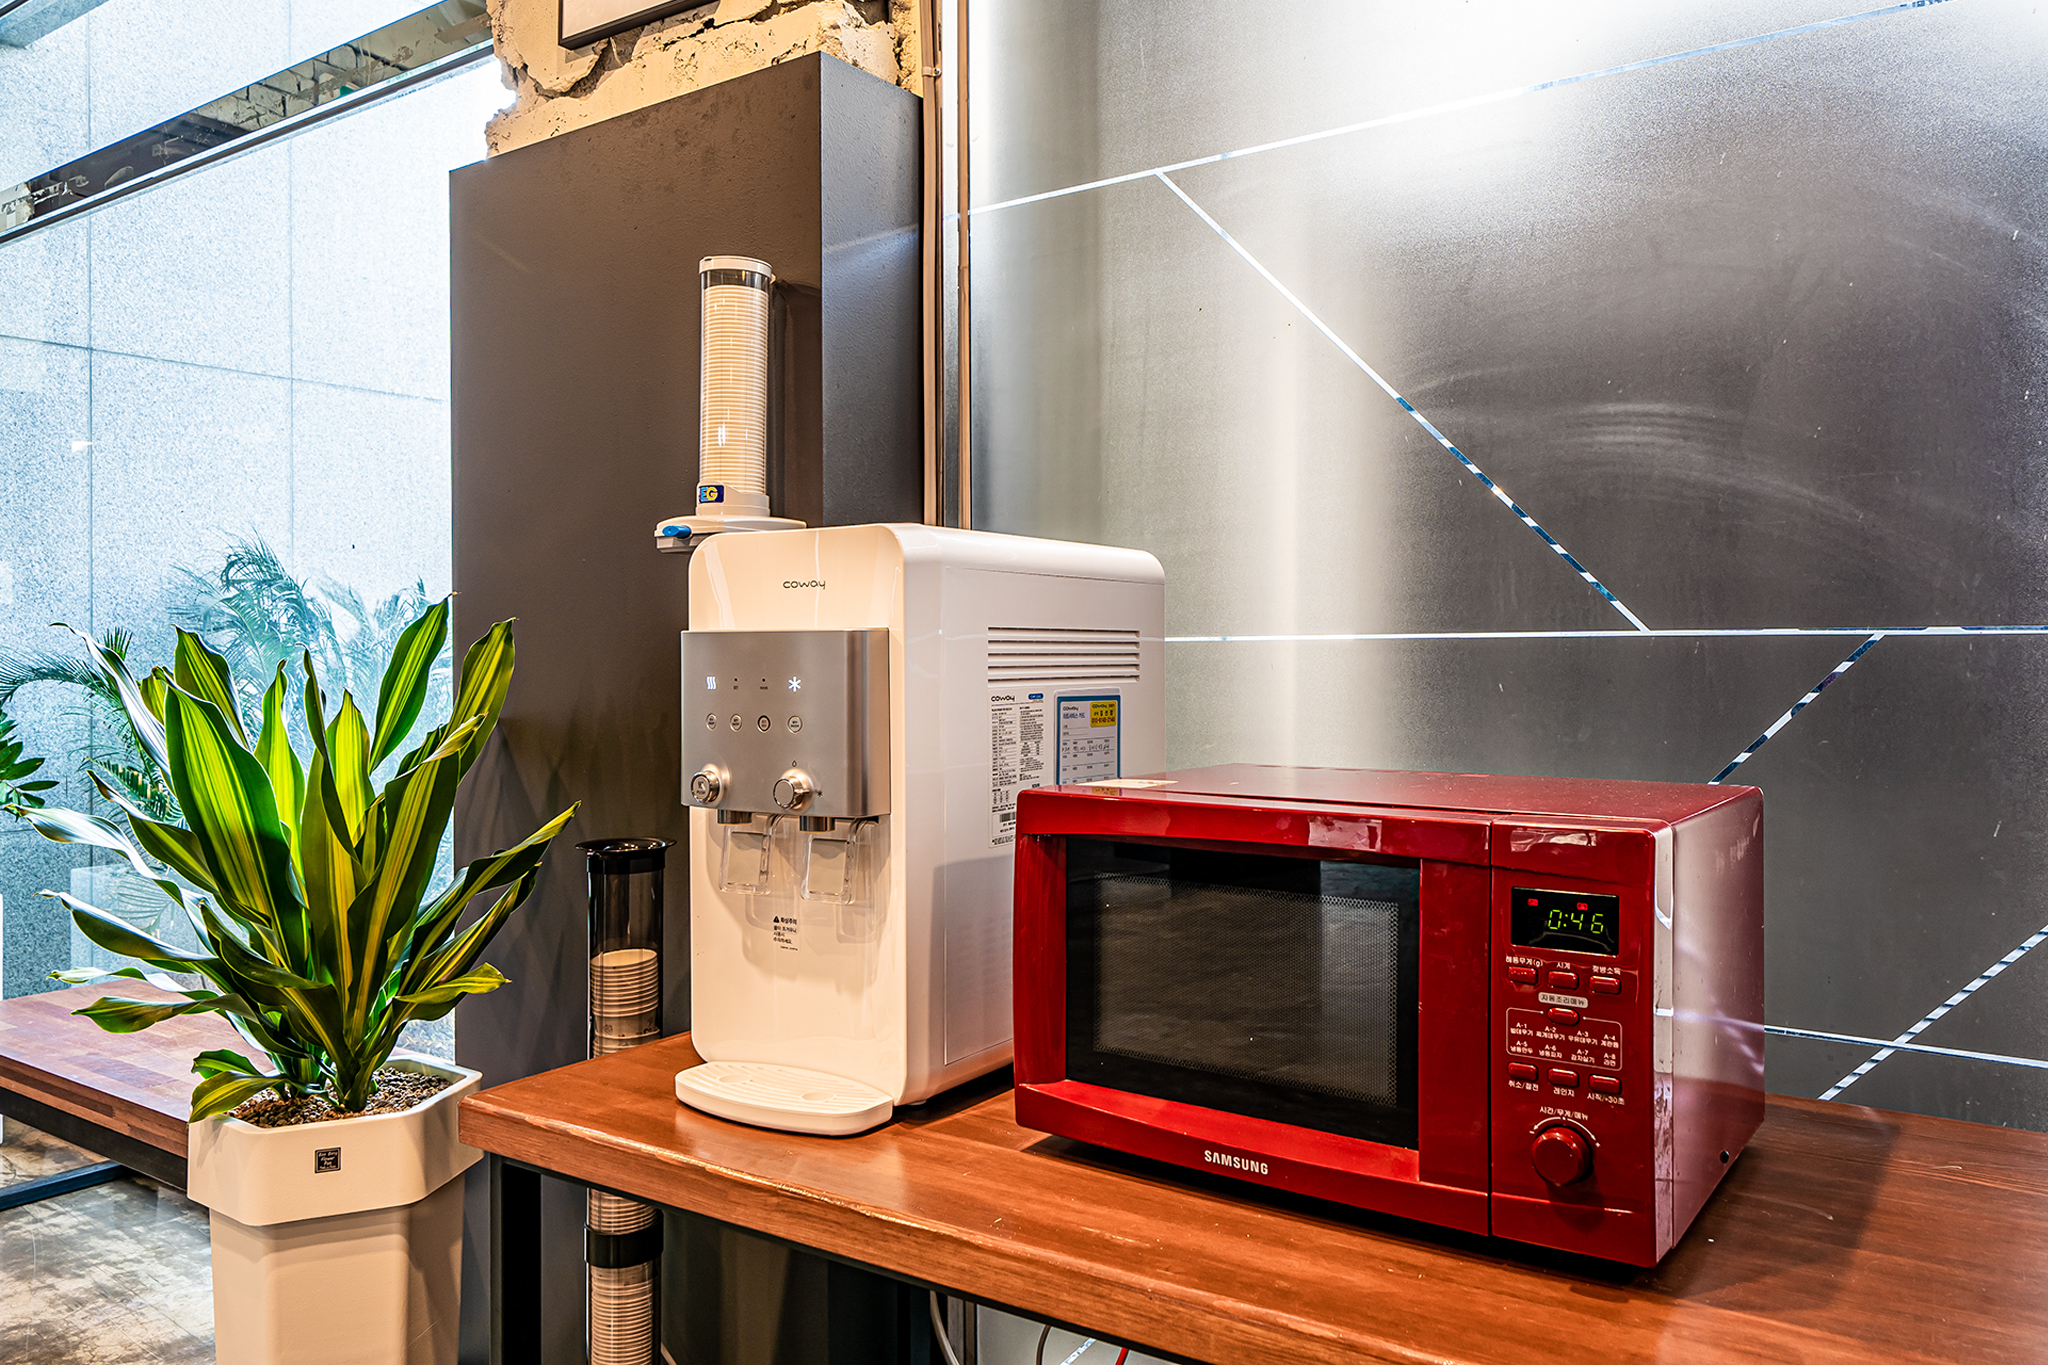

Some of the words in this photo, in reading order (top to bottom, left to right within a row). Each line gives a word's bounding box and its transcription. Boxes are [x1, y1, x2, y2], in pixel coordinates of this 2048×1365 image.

[782, 578, 826, 591] coway
[1547, 909, 1604, 934] 0:46
[1505, 955, 1543, 968] 해동무게(g)
[1556, 961, 1571, 970] 시계
[1541, 994, 1585, 1006] 자동조리메뉴
[1515, 1021, 1527, 1029] A-1
[1544, 1025, 1557, 1033] A-2
[1553, 1087, 1575, 1097] 레인지
[1203, 1149, 1269, 1175] SAMSUNG
